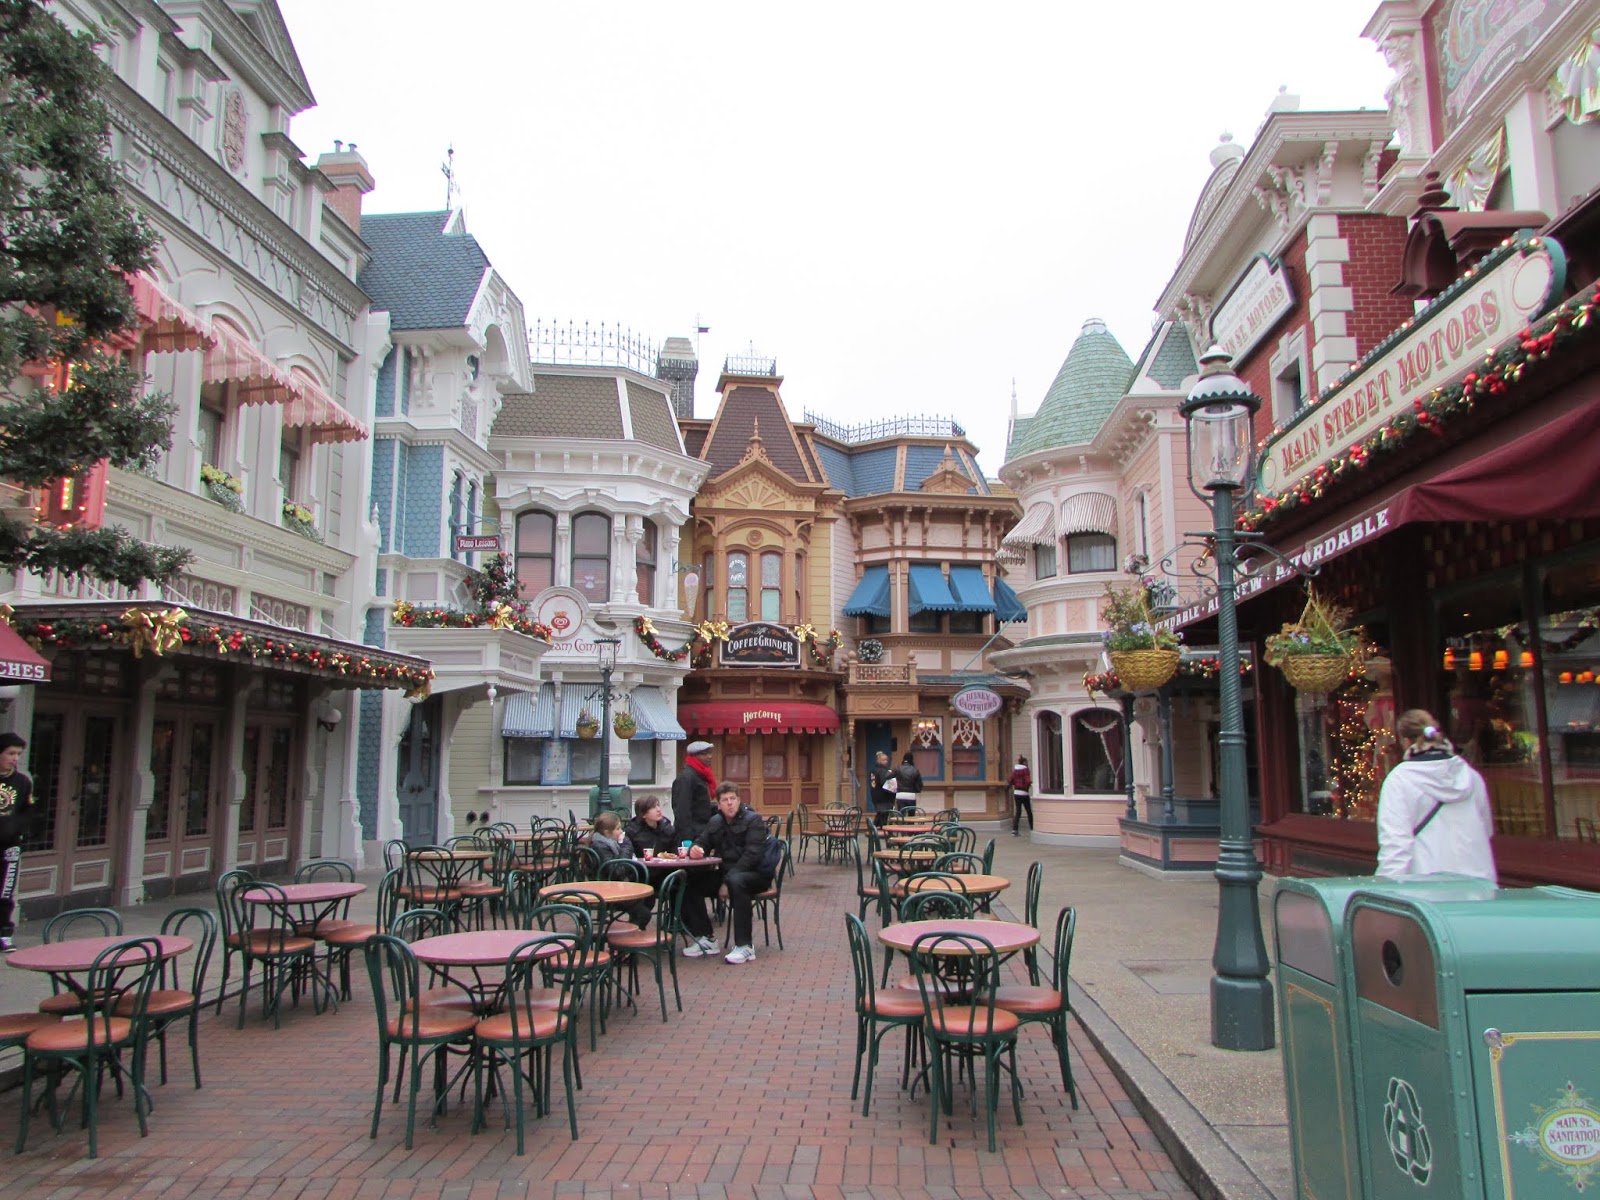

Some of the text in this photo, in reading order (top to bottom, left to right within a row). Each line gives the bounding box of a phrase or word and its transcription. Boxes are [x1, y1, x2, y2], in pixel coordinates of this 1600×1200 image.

[1246, 281, 1284, 333] MOTORS
[1281, 290, 1500, 475] MAIN STREET MOTORS
[574, 638, 622, 654] Comany
[958, 697, 997, 711] CLOTHIERS
[1557, 1116, 1577, 1128] MAIN
